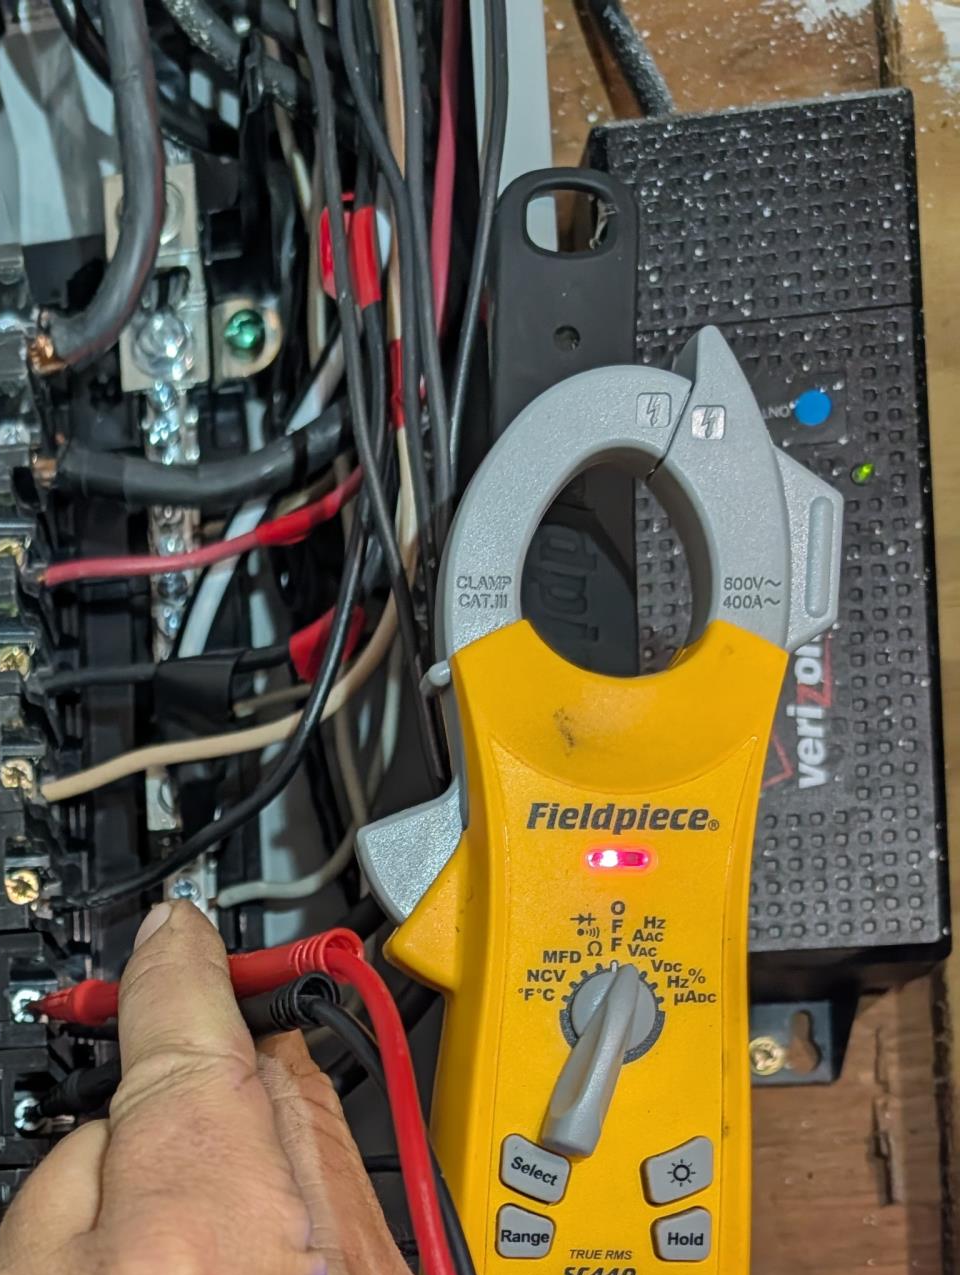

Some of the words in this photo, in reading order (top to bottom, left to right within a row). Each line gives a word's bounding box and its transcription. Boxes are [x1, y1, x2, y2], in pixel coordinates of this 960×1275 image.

[456, 575, 512, 590] CLAMP
[643, 916, 666, 929] Hz
[543, 951, 581, 964] MFD
[527, 970, 566, 982] NCV
[667, 976, 689, 989] Hz
[510, 1156, 558, 1187] Select
[501, 1230, 550, 1246] Range
[667, 1232, 704, 1246] Hold
[569, 1249, 602, 1260] TRUE
[605, 1250, 632, 1260] RMS
